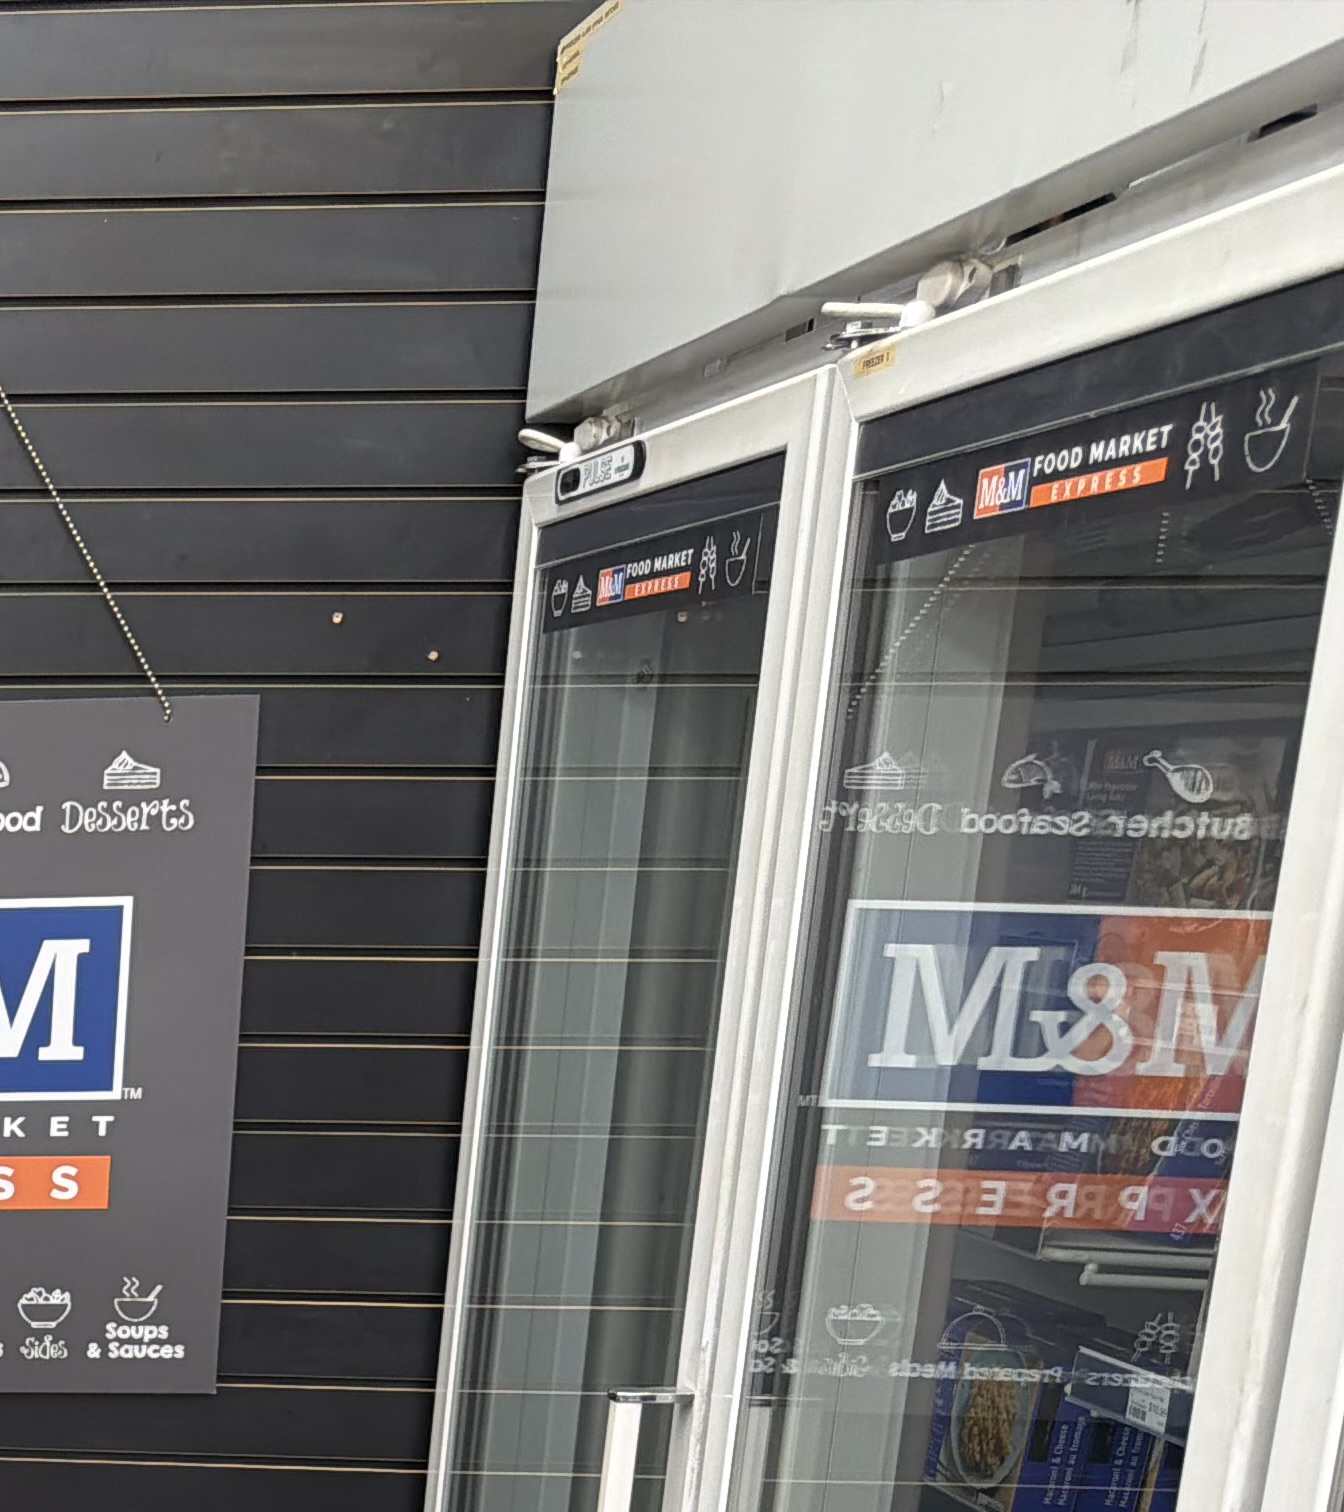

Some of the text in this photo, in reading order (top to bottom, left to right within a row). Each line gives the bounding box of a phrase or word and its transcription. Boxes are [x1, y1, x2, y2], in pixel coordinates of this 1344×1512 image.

[582, 456, 613, 488] PULSE
[979, 423, 1174, 510] M&M FOOD MARKET
[1050, 465, 1144, 502] EXPRESS
[598, 547, 695, 600] M&M FOOD MARKET
[634, 577, 680, 597] EXPRESS
[61, 797, 195, 835] Desserts
[122, 1087, 143, 1100] TM
[105, 1321, 170, 1342] Soups
[20, 1333, 69, 1361] Sides
[86, 1339, 186, 1360] & Sauces
